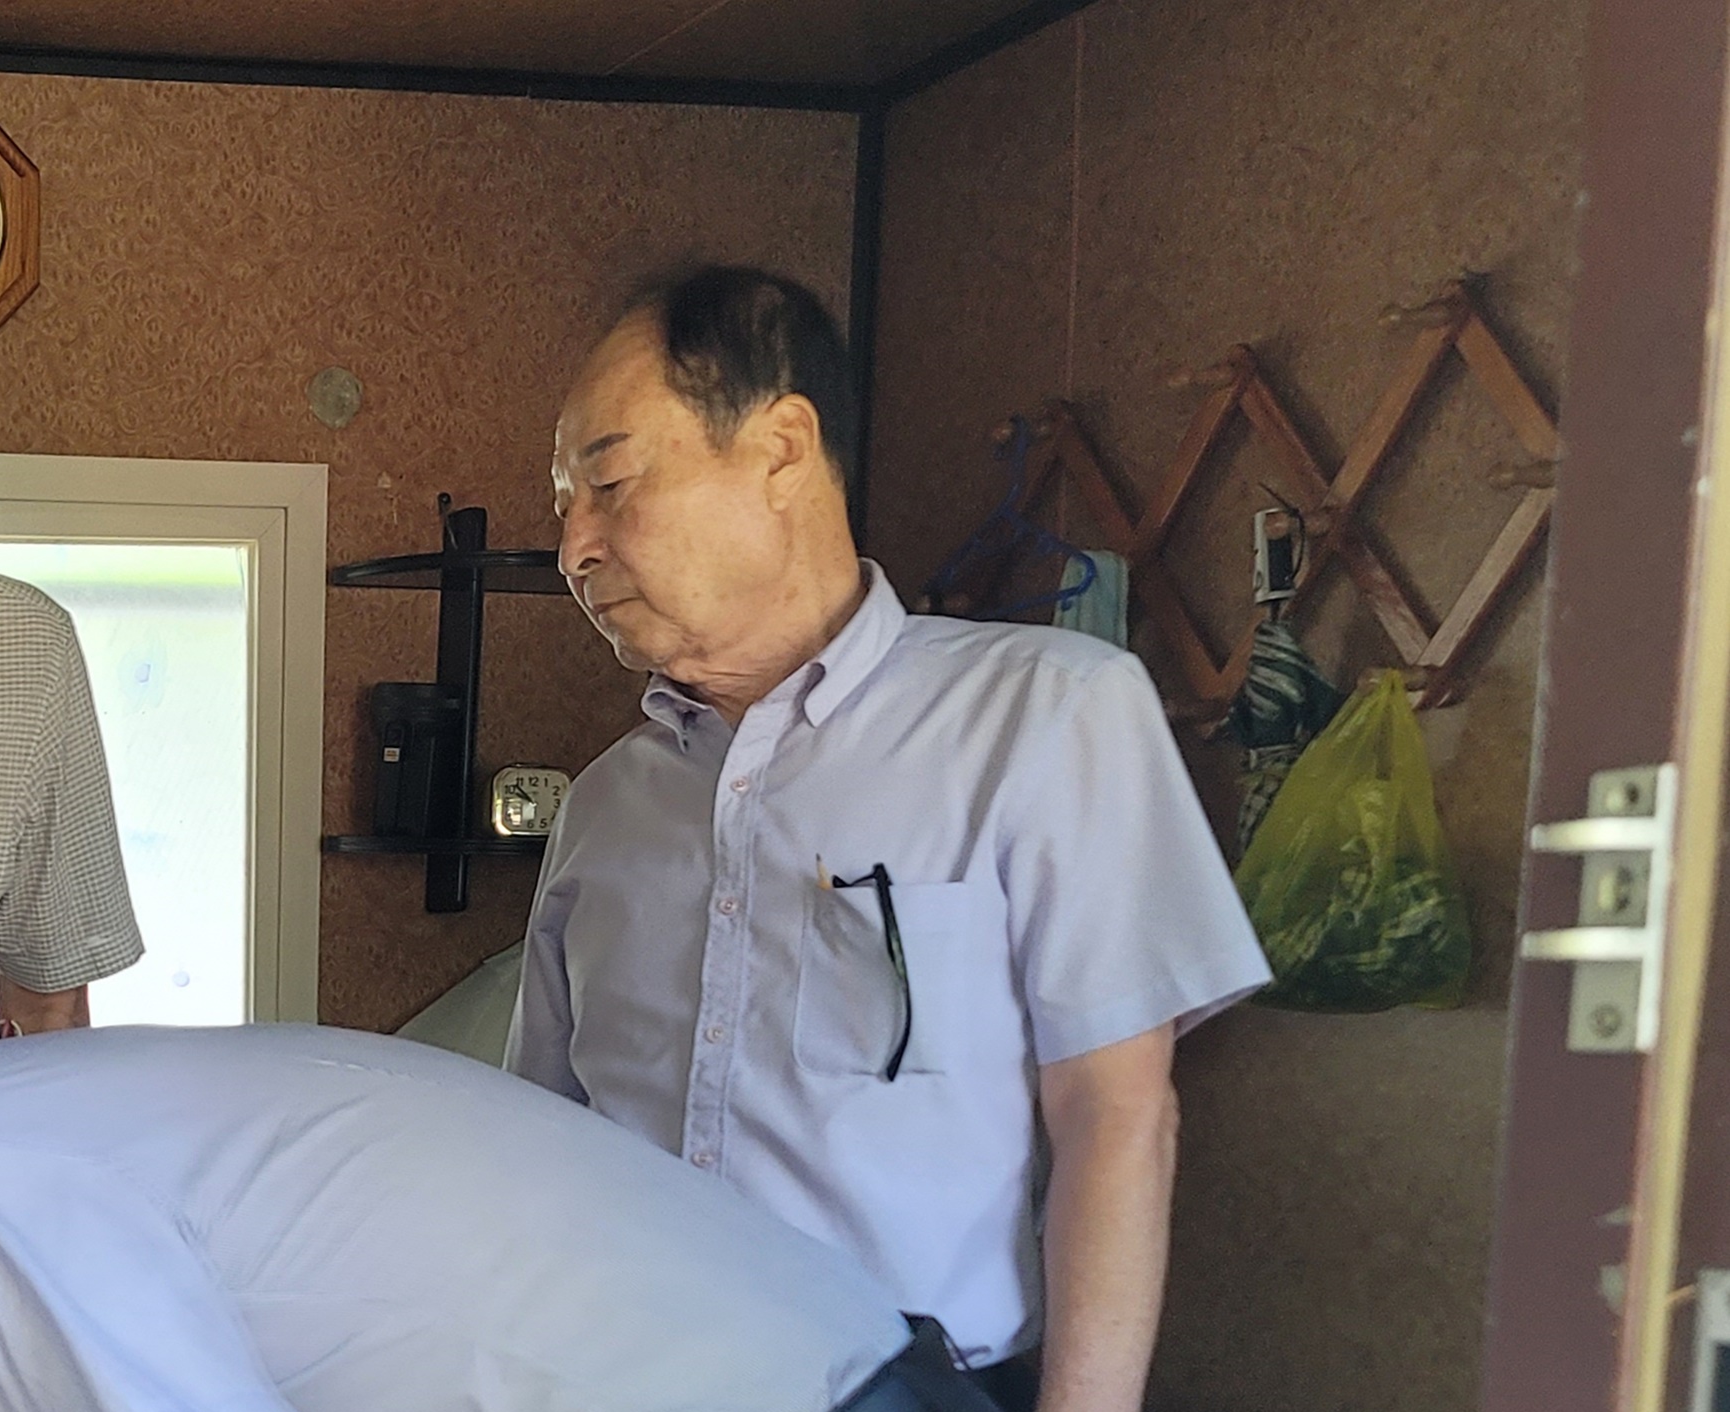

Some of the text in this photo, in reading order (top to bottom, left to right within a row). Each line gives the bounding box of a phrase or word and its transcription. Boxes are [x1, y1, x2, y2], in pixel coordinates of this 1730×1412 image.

[516, 777, 524, 786] 11
[529, 776, 539, 787] 12
[544, 777, 549, 787] 1
[504, 785, 516, 795] 10
[552, 785, 561, 796] 2
[527, 819, 535, 829] 6
[539, 818, 548, 829] 5
